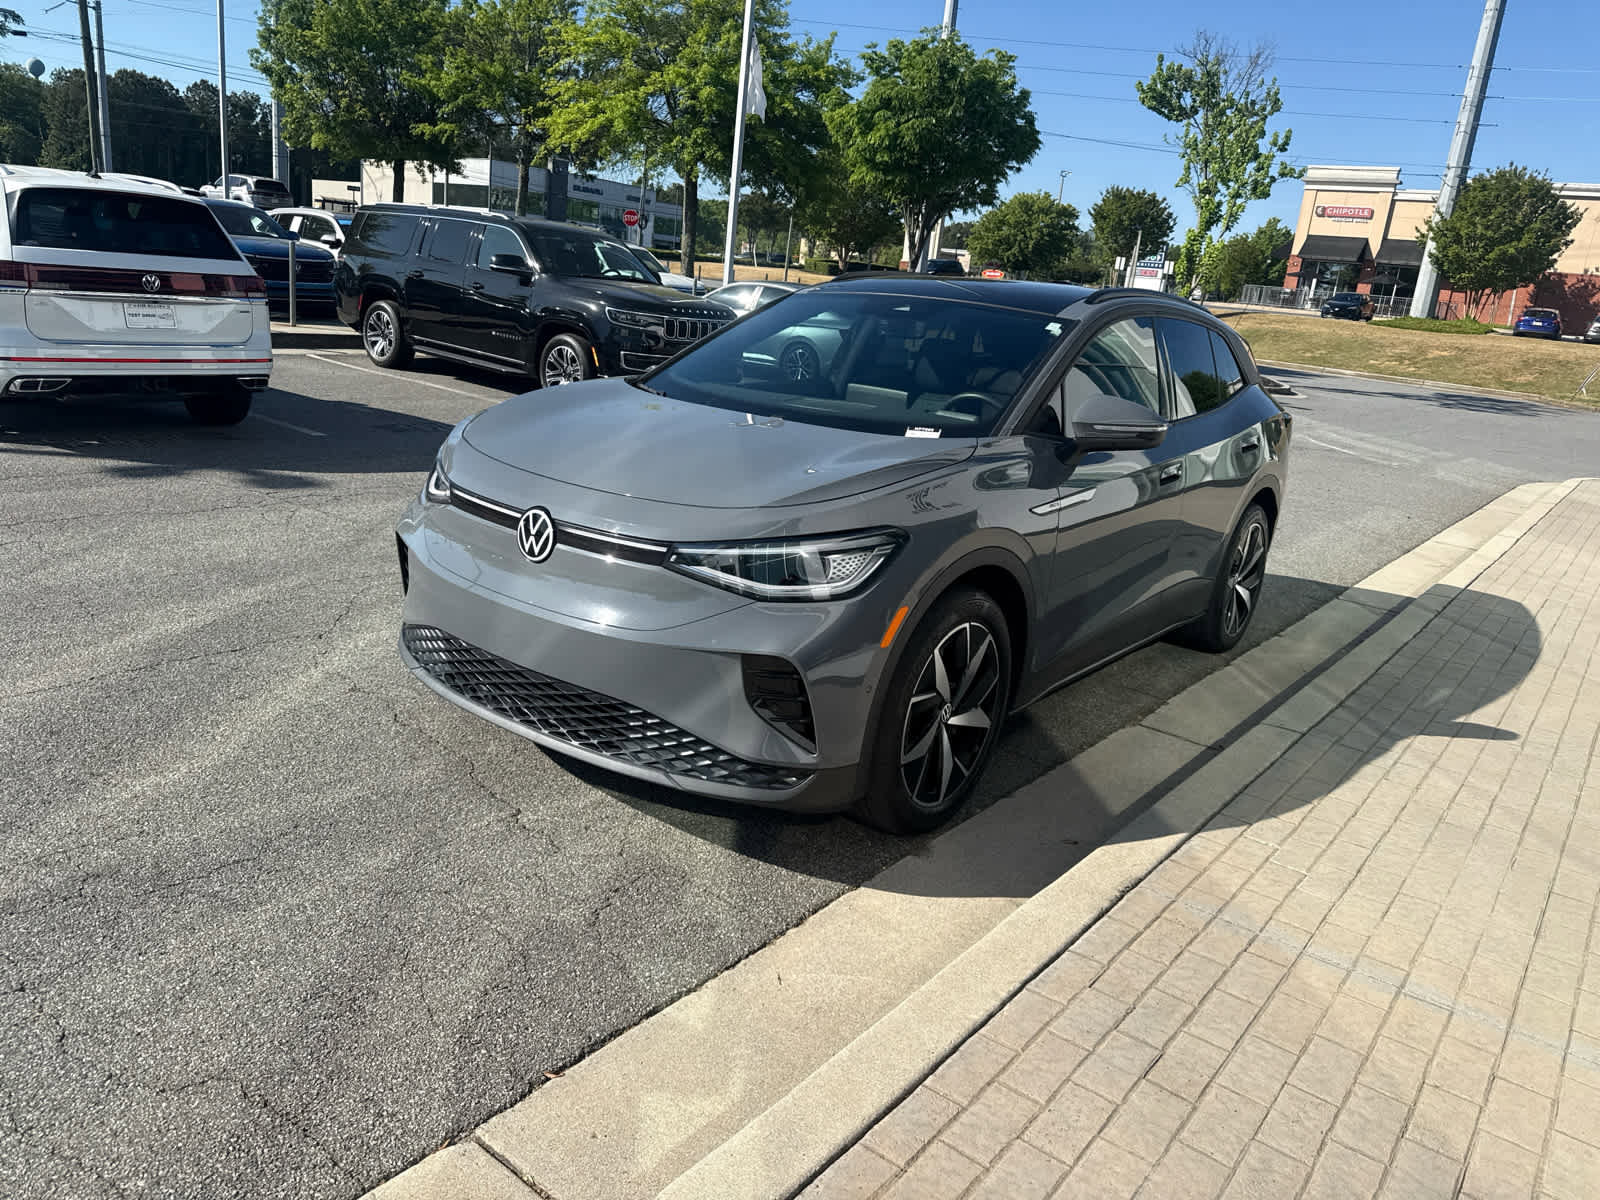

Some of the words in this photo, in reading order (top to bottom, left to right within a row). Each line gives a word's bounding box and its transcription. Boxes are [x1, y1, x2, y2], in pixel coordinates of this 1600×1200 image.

[1327, 207, 1369, 216] CHIPOTLE
[624, 214, 638, 222] STOP
[518, 509, 553, 561] VW
